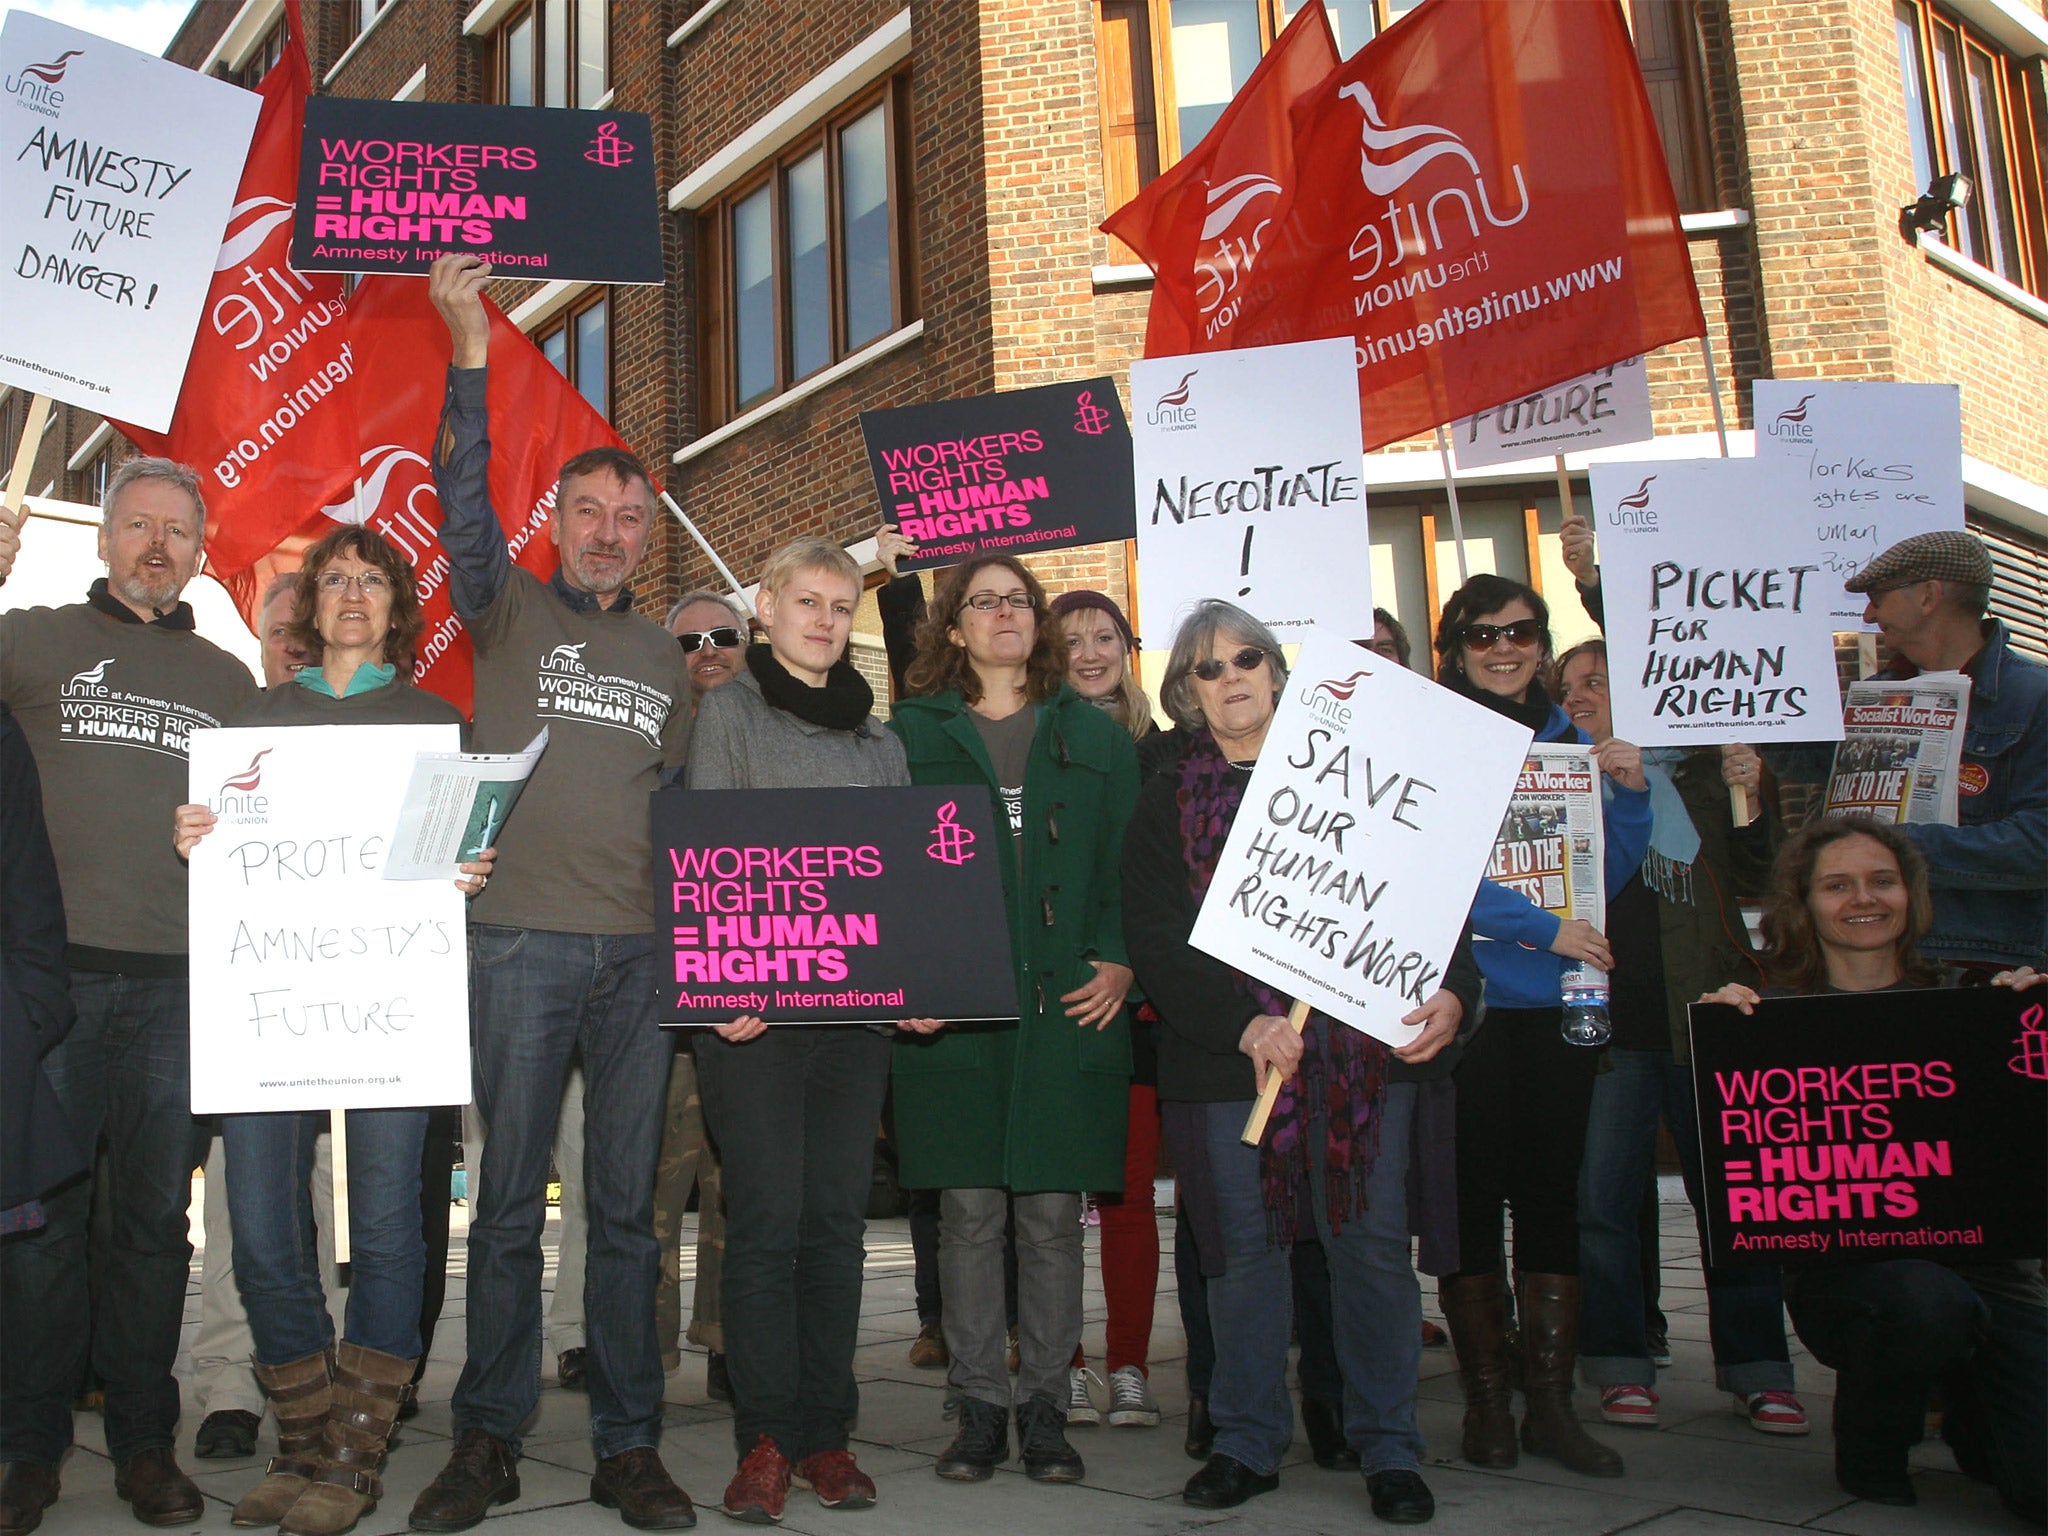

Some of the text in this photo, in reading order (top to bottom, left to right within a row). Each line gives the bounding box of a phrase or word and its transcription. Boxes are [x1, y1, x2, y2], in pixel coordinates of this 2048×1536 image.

[6, 75, 64, 108] unite
[17, 126, 191, 199] AMNESTY
[320, 138, 538, 170] WORKERS
[319, 163, 478, 192] RIGHTS
[44, 185, 155, 239] FUTURE
[351, 189, 527, 220] HUMAN
[71, 229, 105, 253] IN
[314, 213, 493, 244] RIGHTS
[312, 244, 408, 263] Amnesty
[1147, 407, 1196, 425] unite
[1768, 423, 1813, 437] unite
[881, 429, 1044, 472] WORKERS
[1500, 427, 1602, 449] www.unitetheunion.org.uk
[888, 459, 1007, 496] RIGHTS
[1152, 461, 1358, 525] NEGOTIATE
[918, 476, 1050, 516] HUMAN
[900, 503, 1032, 541] RIGHTS
[1609, 510, 1657, 526] unite
[908, 525, 1076, 561] Amnesty International
[1649, 560, 1819, 613] PICKET
[1648, 616, 1708, 645] FOR
[540, 655, 585, 675] unite
[597, 675, 640, 691] Amnesty
[1641, 645, 1786, 687] HUMAN
[61, 683, 108, 698] unite
[111, 692, 122, 700] at
[124, 693, 171, 710] Amnesty
[538, 677, 631, 706] WORKERS
[1301, 688, 1352, 724] unite
[1653, 685, 1807, 718] RIGHTS
[61, 704, 160, 728] WORKERS
[554, 695, 629, 723] HUMAN
[1668, 719, 1786, 729] www.unitetheunion.org.uk
[1852, 706, 1955, 727] Socialist Worker
[78, 720, 156, 743] HUMAN
[1287, 728, 1437, 832] SAVE
[1535, 773, 1590, 790] Worker
[1831, 772, 1858, 803] TAKE
[1856, 771, 1875, 801] TO
[1874, 770, 1906, 801] THE
[1267, 786, 1356, 855] OUR
[228, 835, 384, 886] PROTE
[669, 845, 883, 879] WORKERS
[1245, 827, 1389, 912] HUMAN
[1508, 840, 1532, 874] TO
[1533, 837, 1563, 871] THE
[673, 880, 828, 913] RIGHTS
[230, 920, 451, 964] AMNESTY'S
[706, 914, 878, 947] HUMAN
[1229, 872, 1440, 1006] RIGHTS WORK
[675, 949, 849, 984] RIGHTS
[1251, 945, 1367, 1009] www.unitetheunion.org.uk
[249, 988, 415, 1037] FUTURE
[677, 989, 904, 1011] Amnesty International
[259, 1076, 402, 1089] www.unitetheunion.org.uk
[1714, 1060, 1956, 1106] WORKERS
[1721, 1103, 1894, 1145] RIGHTS
[1759, 1140, 1952, 1182] HUMAN
[1727, 1181, 1919, 1223] RIGHTS
[1732, 1225, 1984, 1252] Amnesty International
